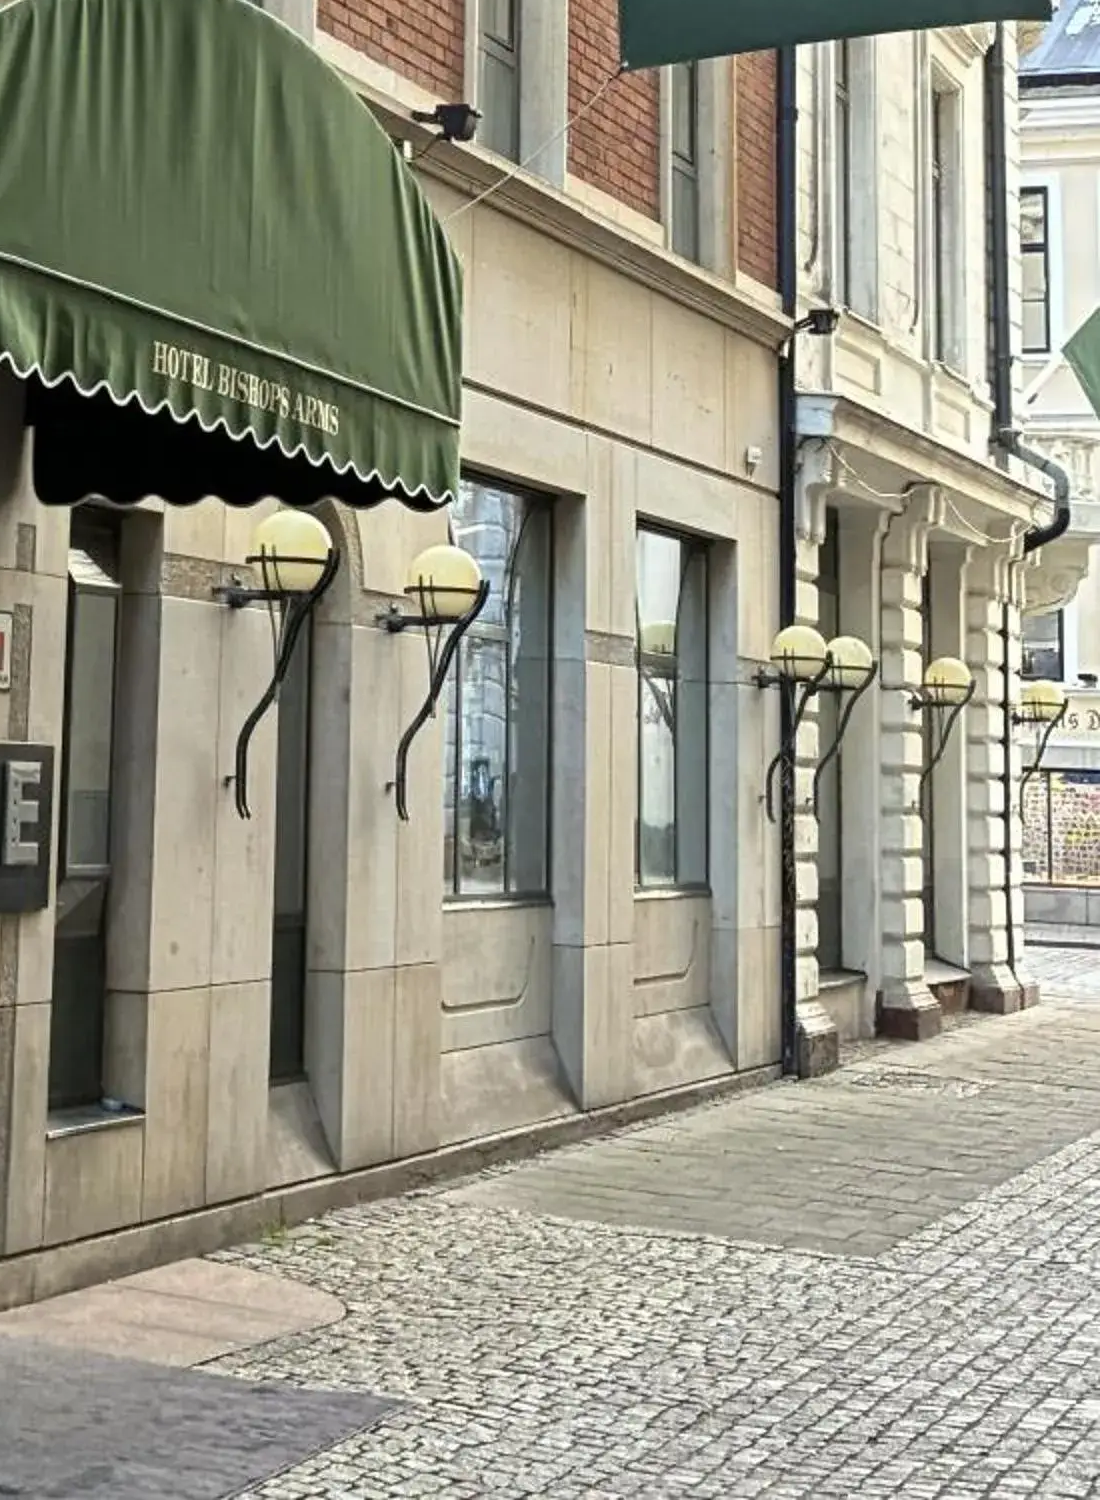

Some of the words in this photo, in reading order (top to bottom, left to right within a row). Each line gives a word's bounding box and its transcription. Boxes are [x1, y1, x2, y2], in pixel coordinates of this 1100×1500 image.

[153, 341, 213, 390] HOTEL
[218, 364, 290, 418] BISHOPS
[293, 393, 339, 436] ARMS
